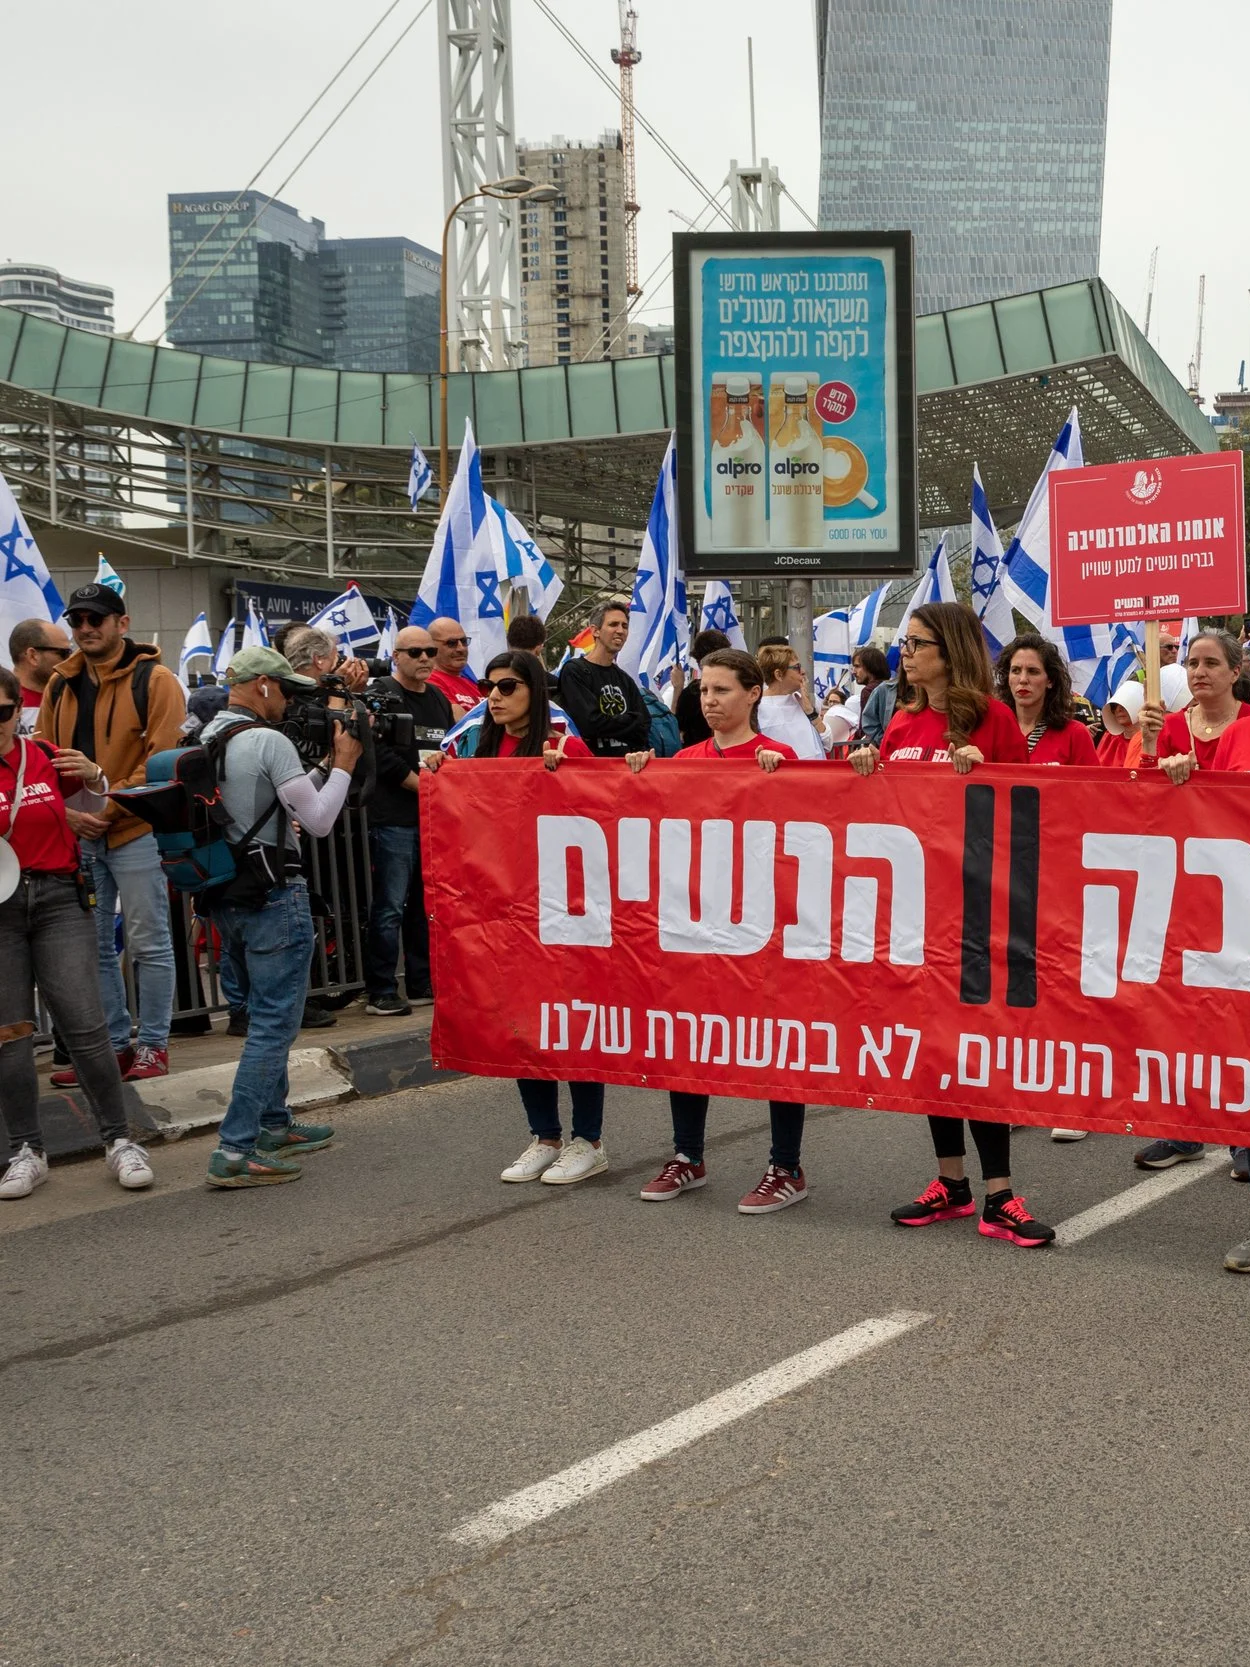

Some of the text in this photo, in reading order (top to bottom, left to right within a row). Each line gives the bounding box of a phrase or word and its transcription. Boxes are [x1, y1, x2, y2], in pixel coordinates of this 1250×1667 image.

[212, 199, 250, 213] GROUP
[528, 212, 539, 224] 32
[720, 270, 868, 294] תתכוננו לקראש חדש!
[719, 295, 869, 327] משקאות מעולים
[720, 326, 869, 362] לקפה ולהקצפה
[829, 388, 848, 402] חדש
[823, 397, 847, 416] במקרר
[716, 457, 762, 479] alpro
[774, 457, 820, 479] alpro
[725, 484, 754, 497] שקדים
[772, 484, 822, 496] שיבולת שועל
[828, 529, 888, 540] GOOD FOR YOU!
[1068, 517, 1225, 552] אנחנו האלטרנטיבה
[774, 557, 821, 566] JCDecaux
[1081, 551, 1215, 580] גברים ונשים למען שוויון
[244, 595, 263, 611] TEL
[267, 597, 291, 614] AVIV
[1114, 594, 1180, 609] מאבק הנשים
[536, 814, 926, 966] הנשים
[539, 999, 632, 1055] שלנו
[644, 1010, 841, 1075] במשמרת
[858, 1023, 922, 1080] לא
[938, 1032, 1113, 1099] הנשים,
